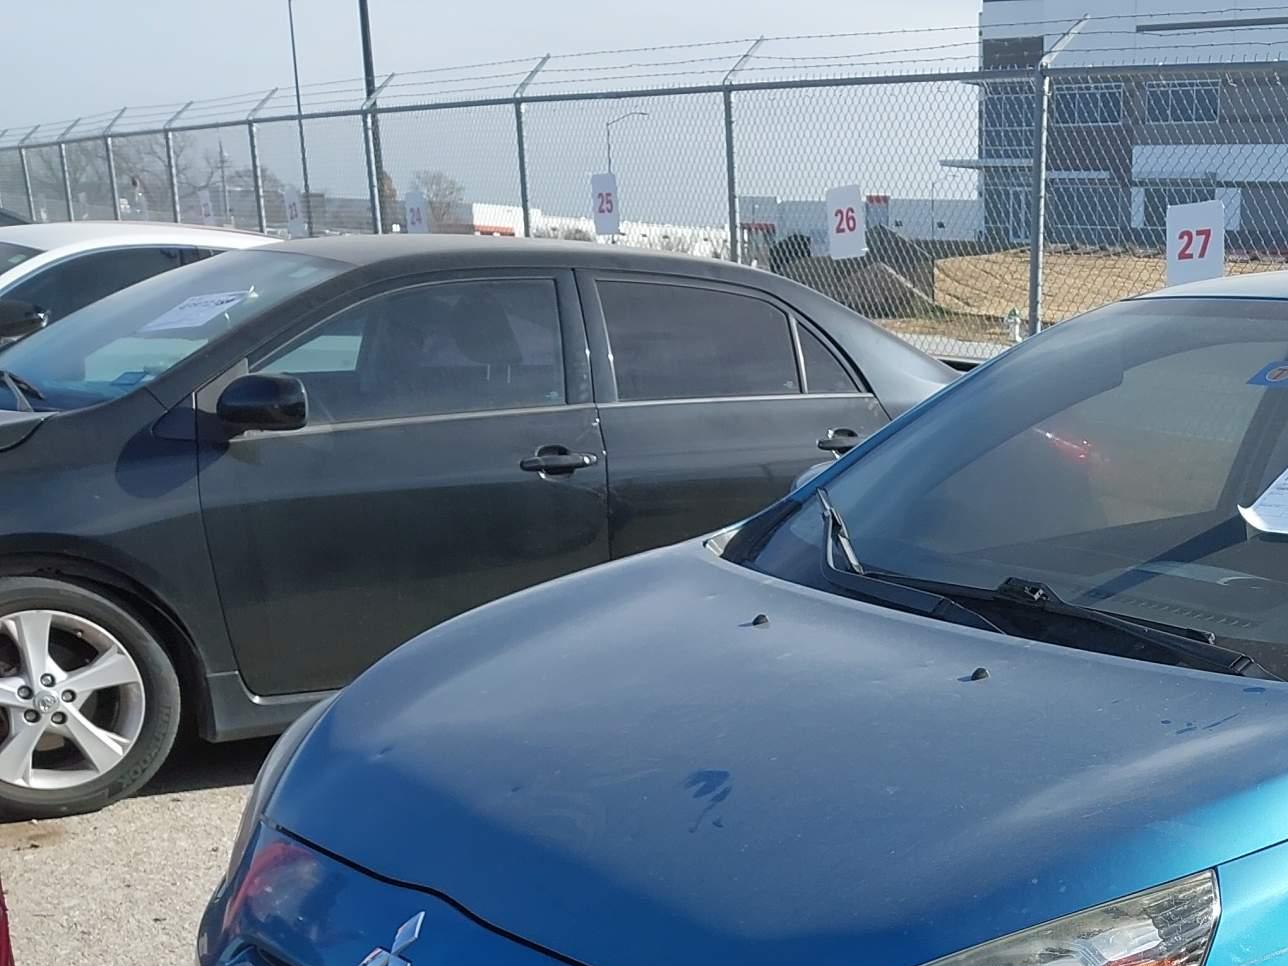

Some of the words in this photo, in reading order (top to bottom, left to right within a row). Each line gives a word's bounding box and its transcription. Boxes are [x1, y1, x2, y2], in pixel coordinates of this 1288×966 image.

[597, 192, 614, 214] 25
[834, 207, 857, 233] 26
[1177, 228, 1212, 261] 27
